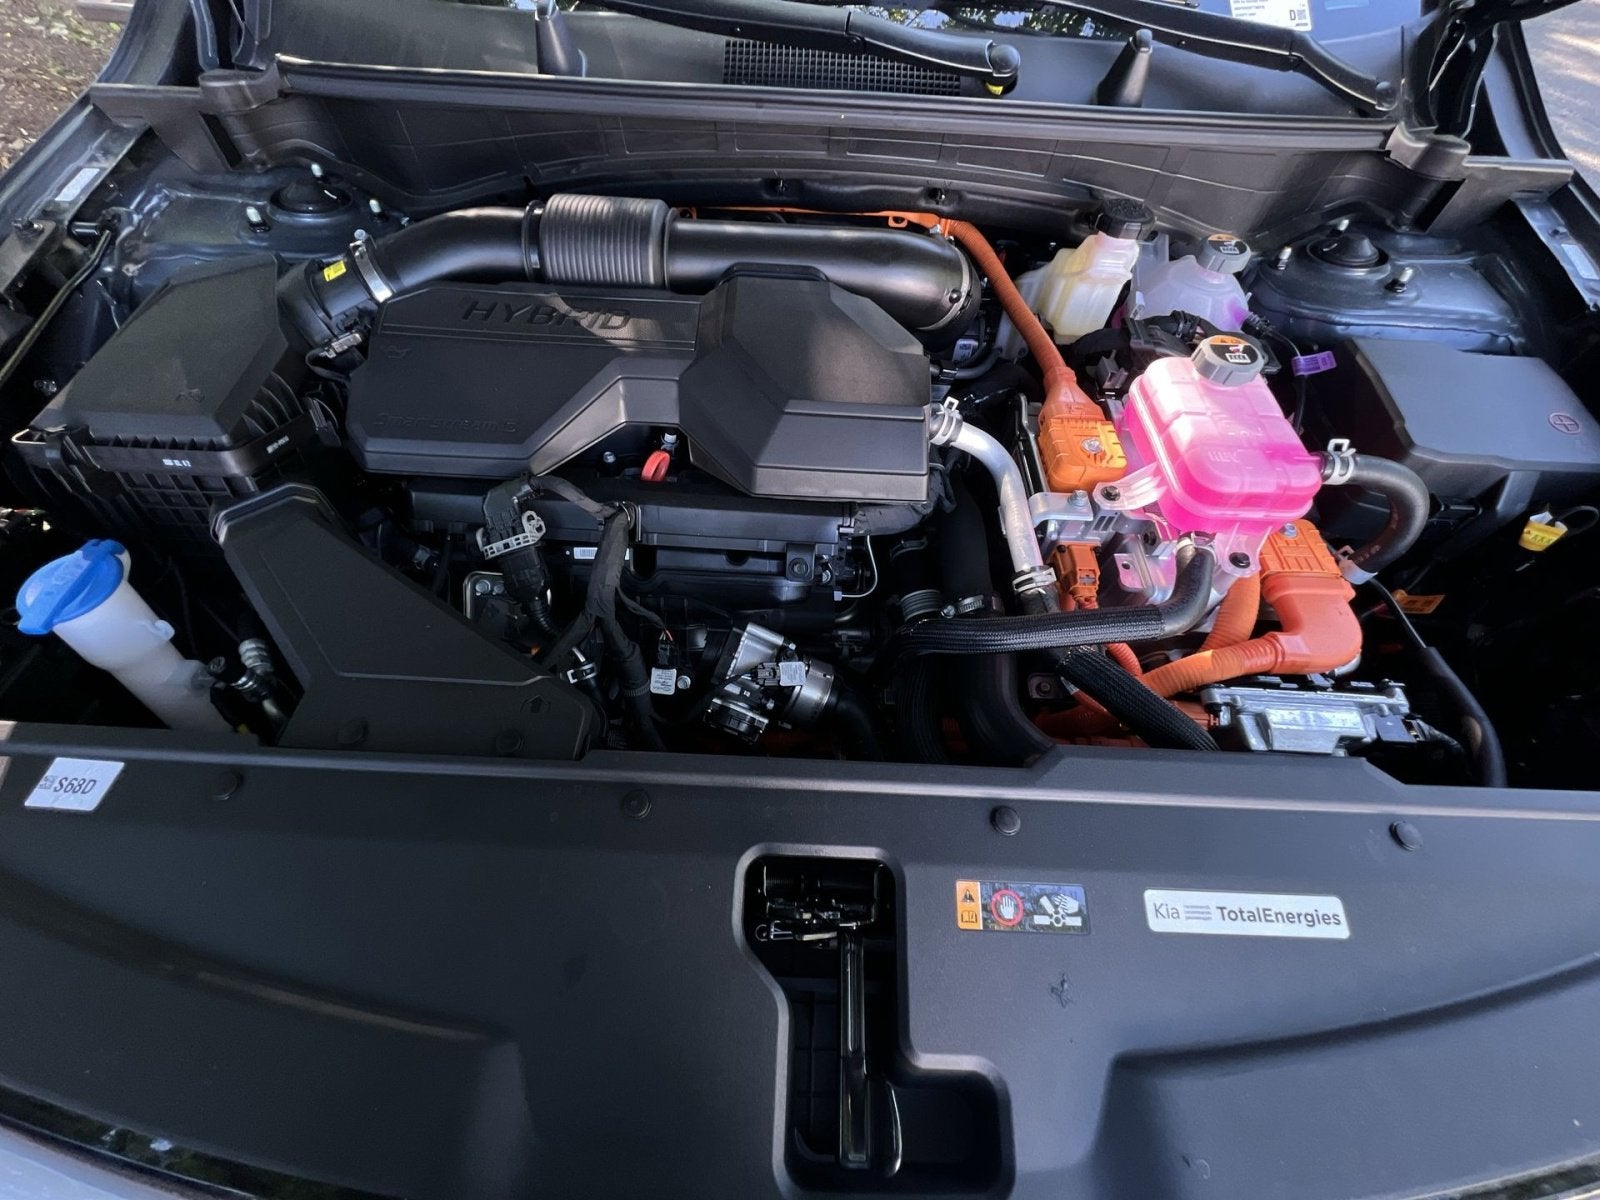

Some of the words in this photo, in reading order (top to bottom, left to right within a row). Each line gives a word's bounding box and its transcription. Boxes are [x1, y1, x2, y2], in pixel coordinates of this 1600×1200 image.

[461, 300, 631, 331] HYBRID
[53, 776, 97, 795] S68D
[1153, 902, 1181, 920] Kia
[1216, 905, 1342, 928] TotalEnergies
